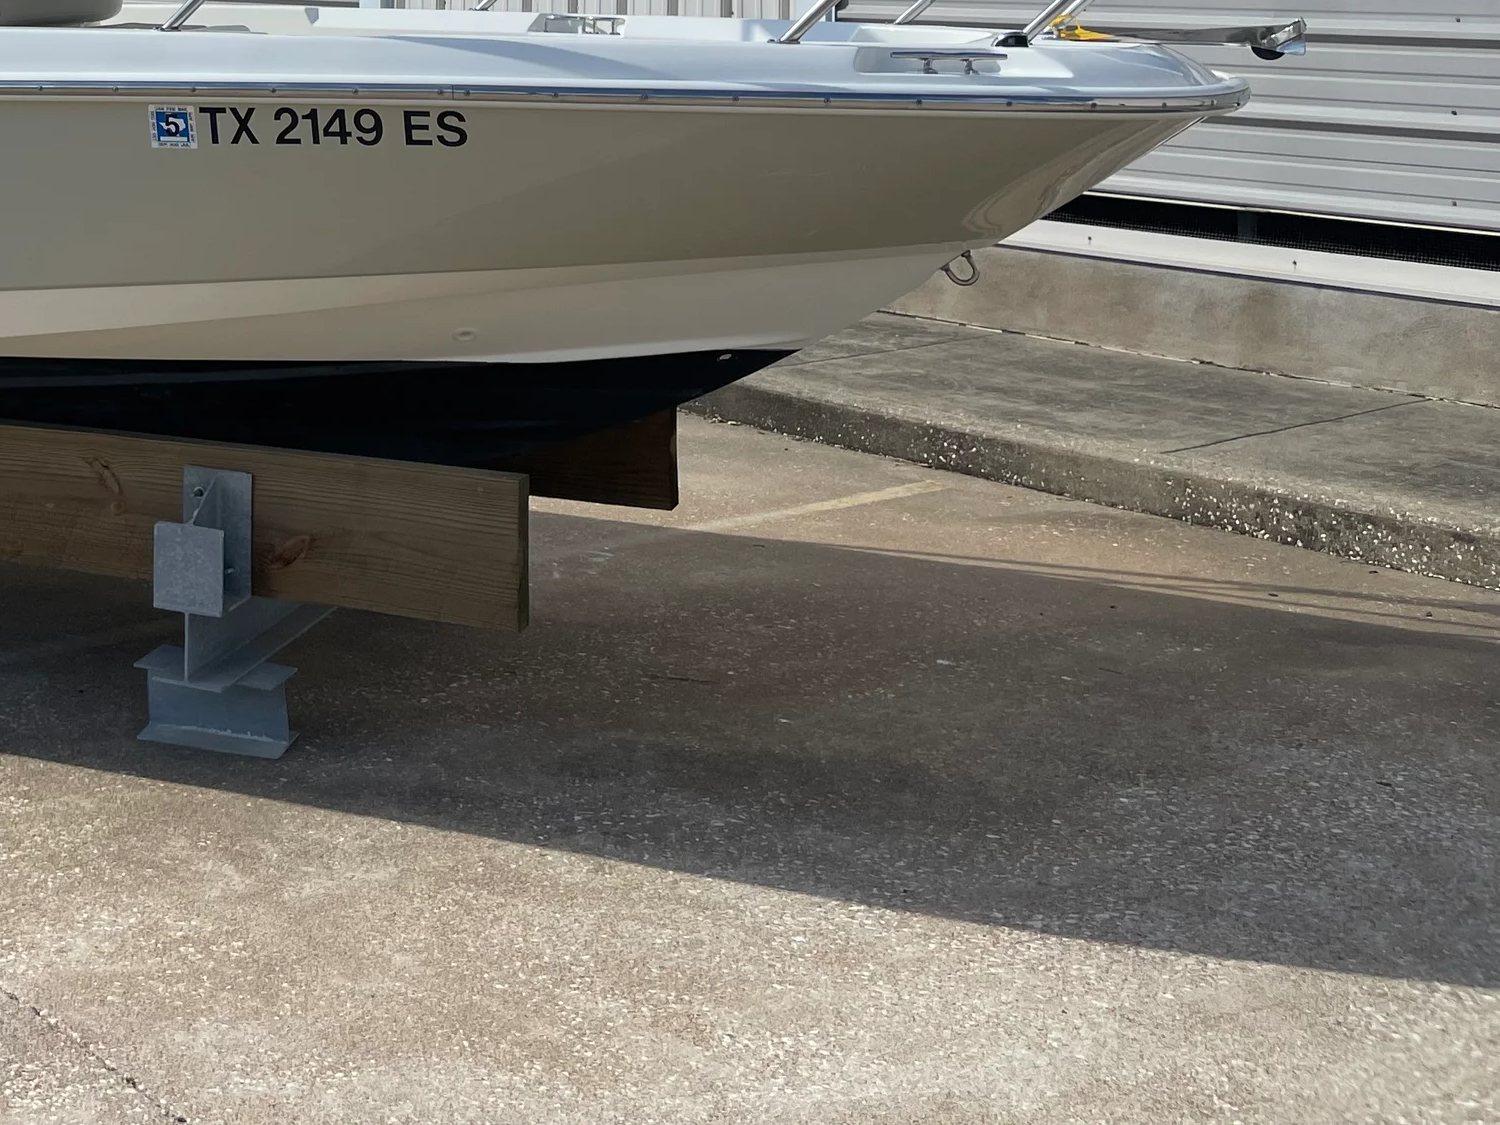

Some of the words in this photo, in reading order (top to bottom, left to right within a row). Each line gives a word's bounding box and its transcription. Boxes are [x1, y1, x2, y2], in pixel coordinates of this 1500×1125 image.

[165, 112, 181, 137] 5
[199, 107, 260, 144] TX
[273, 108, 383, 146] 2149
[404, 110, 468, 147] ES
